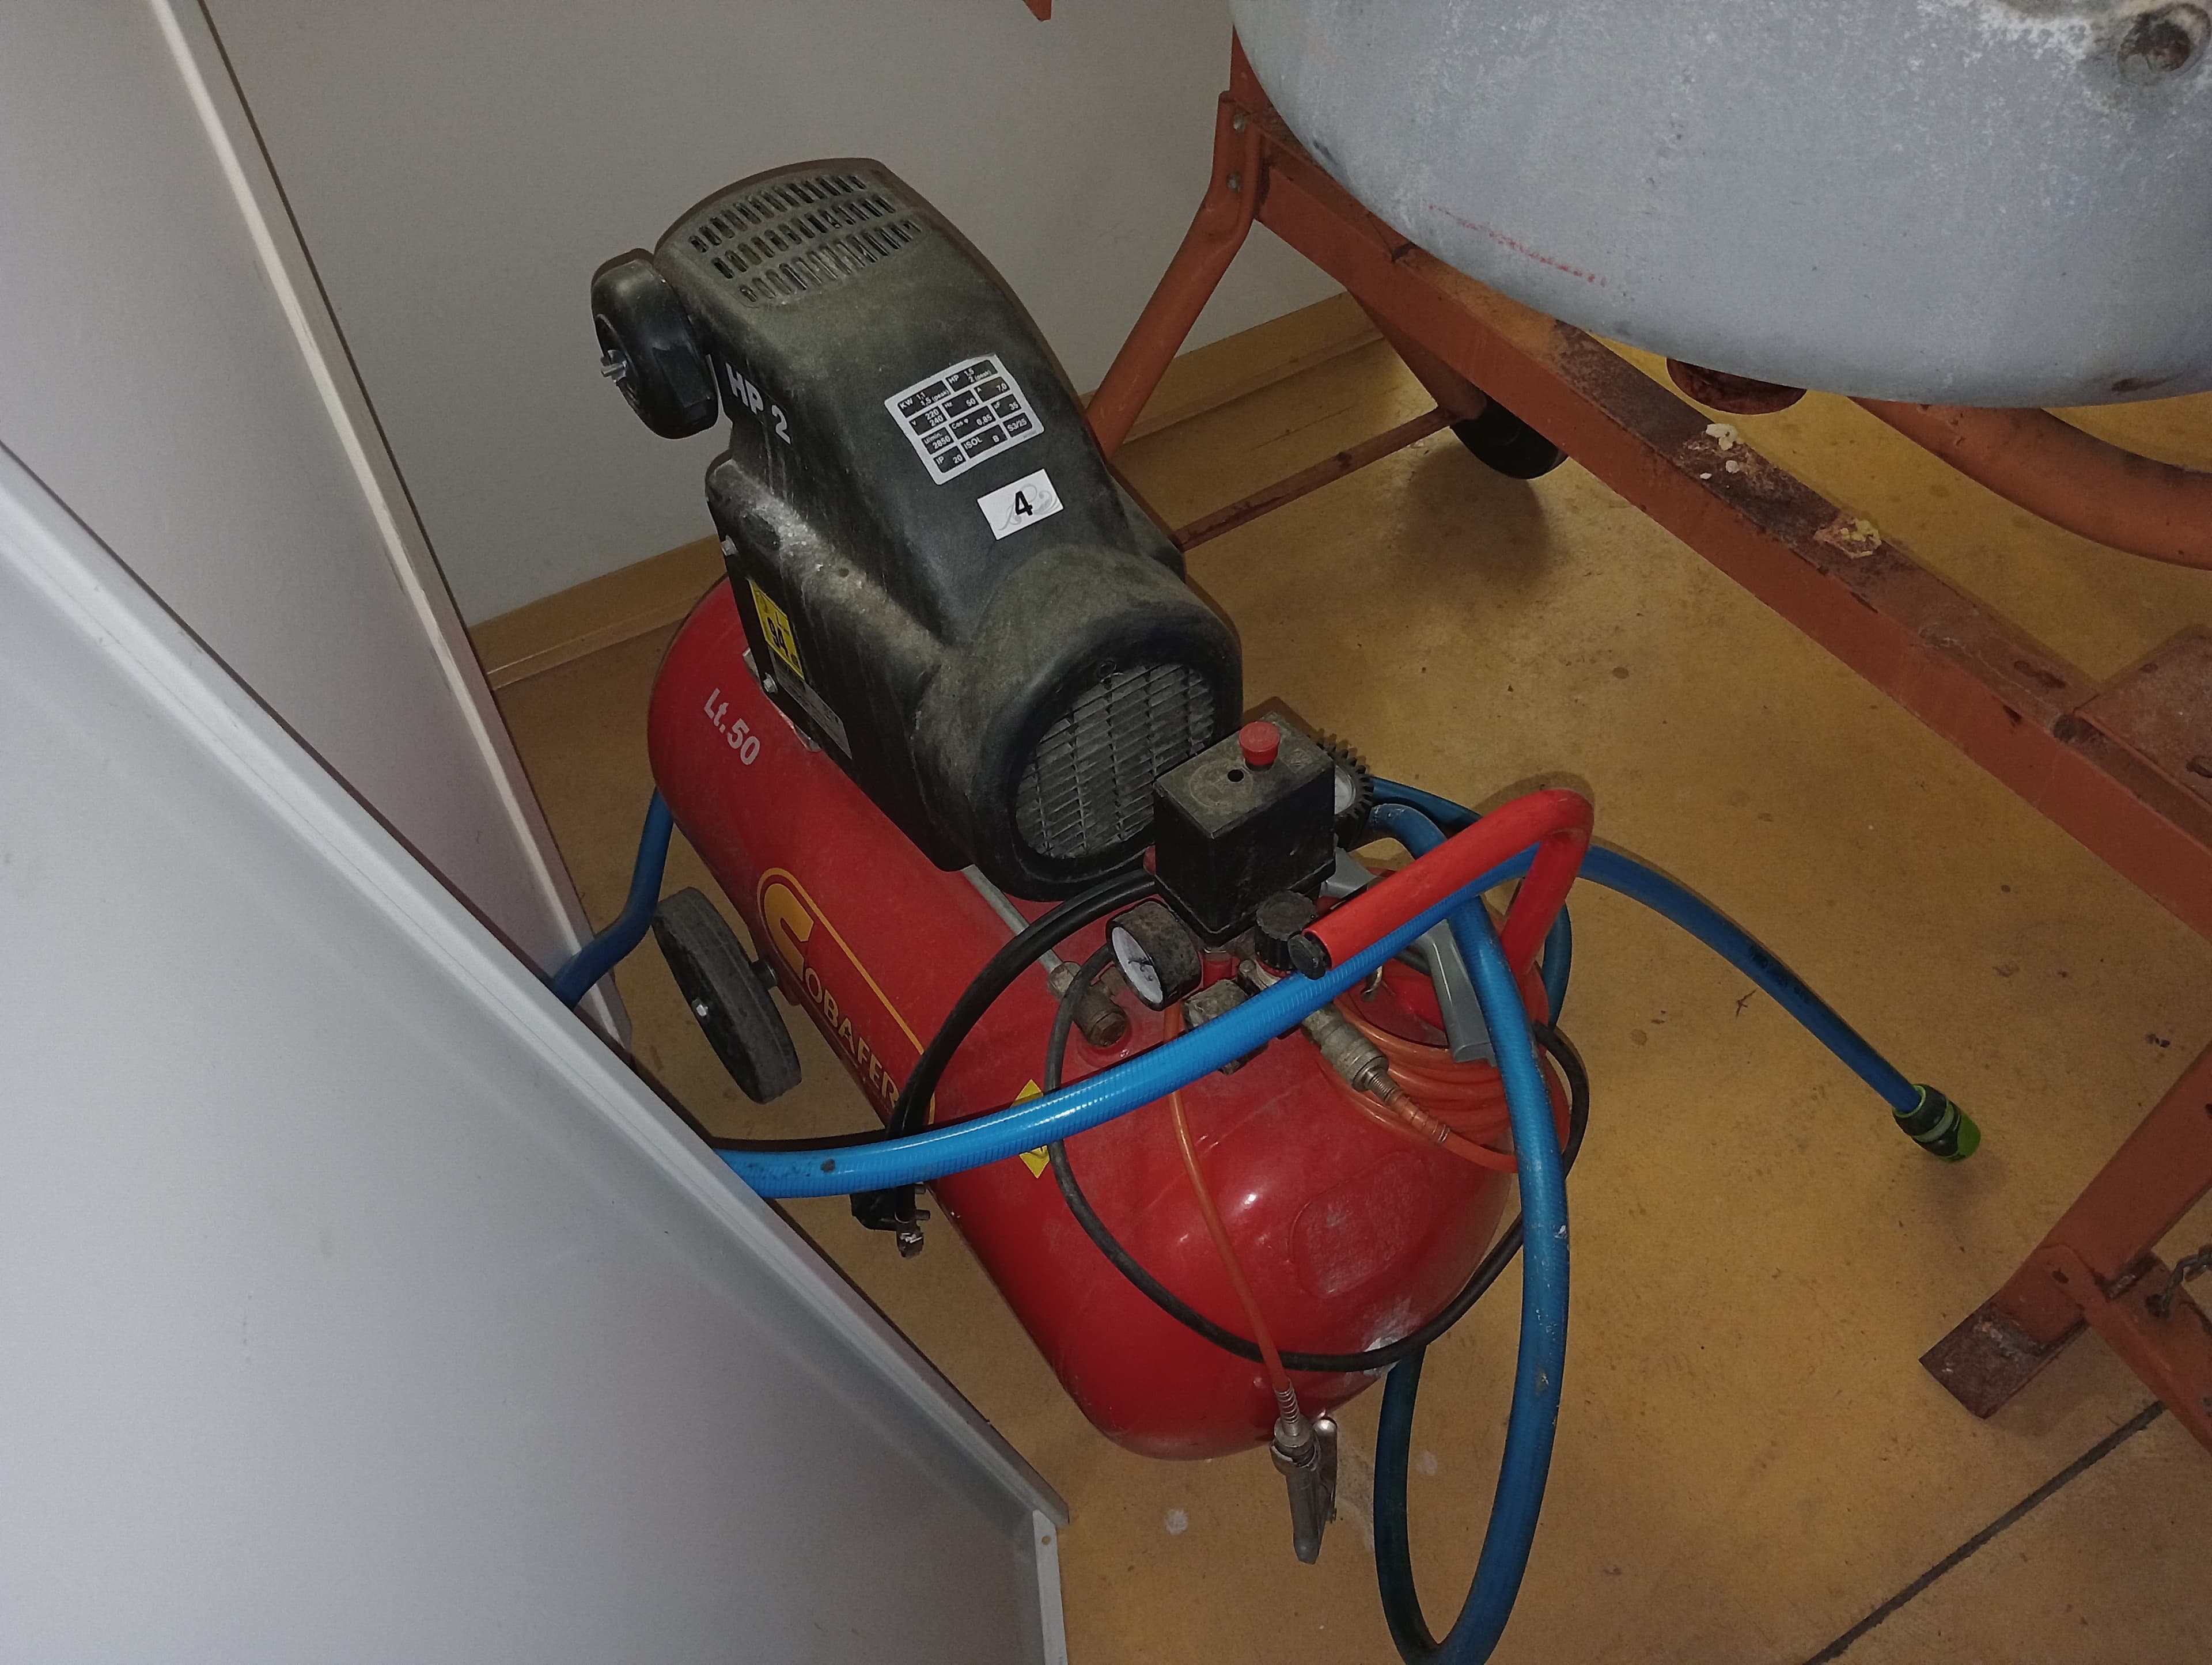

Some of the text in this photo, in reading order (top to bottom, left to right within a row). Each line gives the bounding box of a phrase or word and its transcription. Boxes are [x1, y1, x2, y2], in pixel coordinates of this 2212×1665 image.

[948, 374, 959, 384] HP
[996, 383, 1007, 392] 7,0
[931, 389, 950, 402] (peak)
[725, 362, 791, 445] HP 2
[899, 397, 913, 409] KW
[966, 398, 976, 407] 50
[1009, 402, 1018, 411] 35
[925, 408, 939, 420] 220
[929, 415, 944, 426] 240
[952, 421, 963, 430] Cos
[976, 414, 993, 426] 0,85
[1007, 418, 1027, 432] S3/25
[932, 435, 951, 449] 2850
[964, 435, 999, 450] ISOL B
[935, 454, 963, 465] IP 20
[1015, 491, 1033, 516] 4
